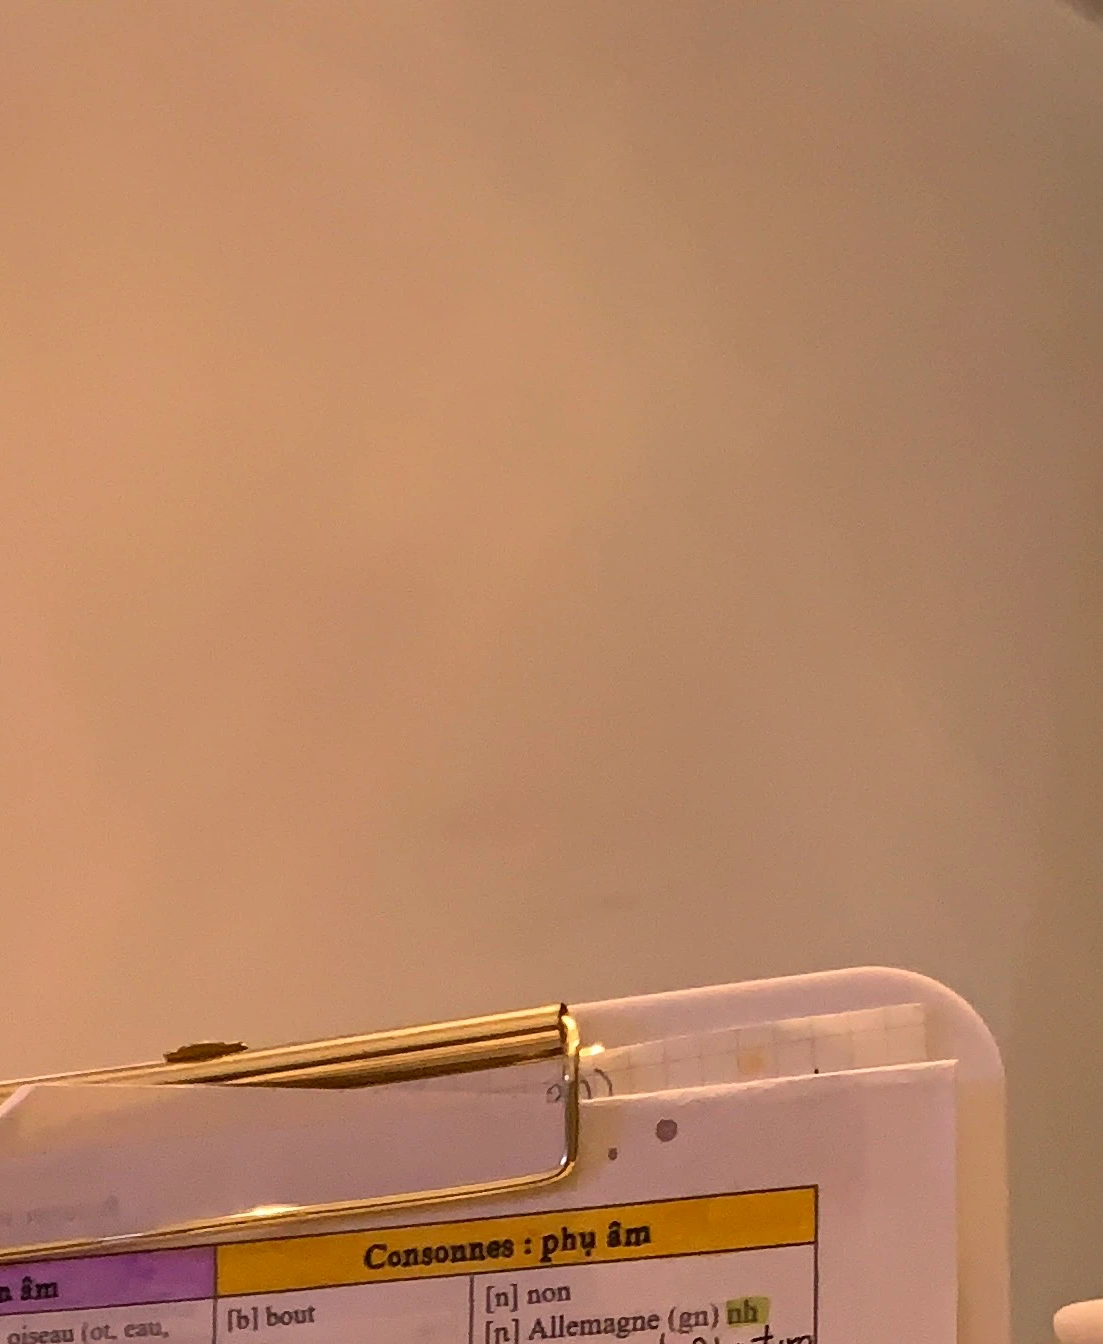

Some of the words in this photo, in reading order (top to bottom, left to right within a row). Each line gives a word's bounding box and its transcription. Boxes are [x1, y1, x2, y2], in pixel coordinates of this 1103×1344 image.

[364, 1239, 515, 1270] Consonnes
[540, 1226, 597, 1262] phụ
[607, 1220, 651, 1247] âm
[20, 1276, 59, 1300] âm
[527, 1285, 572, 1305] non
[265, 1305, 316, 1327] bout
[528, 1312, 660, 1340] Allemagne
[727, 1299, 758, 1324] nh
